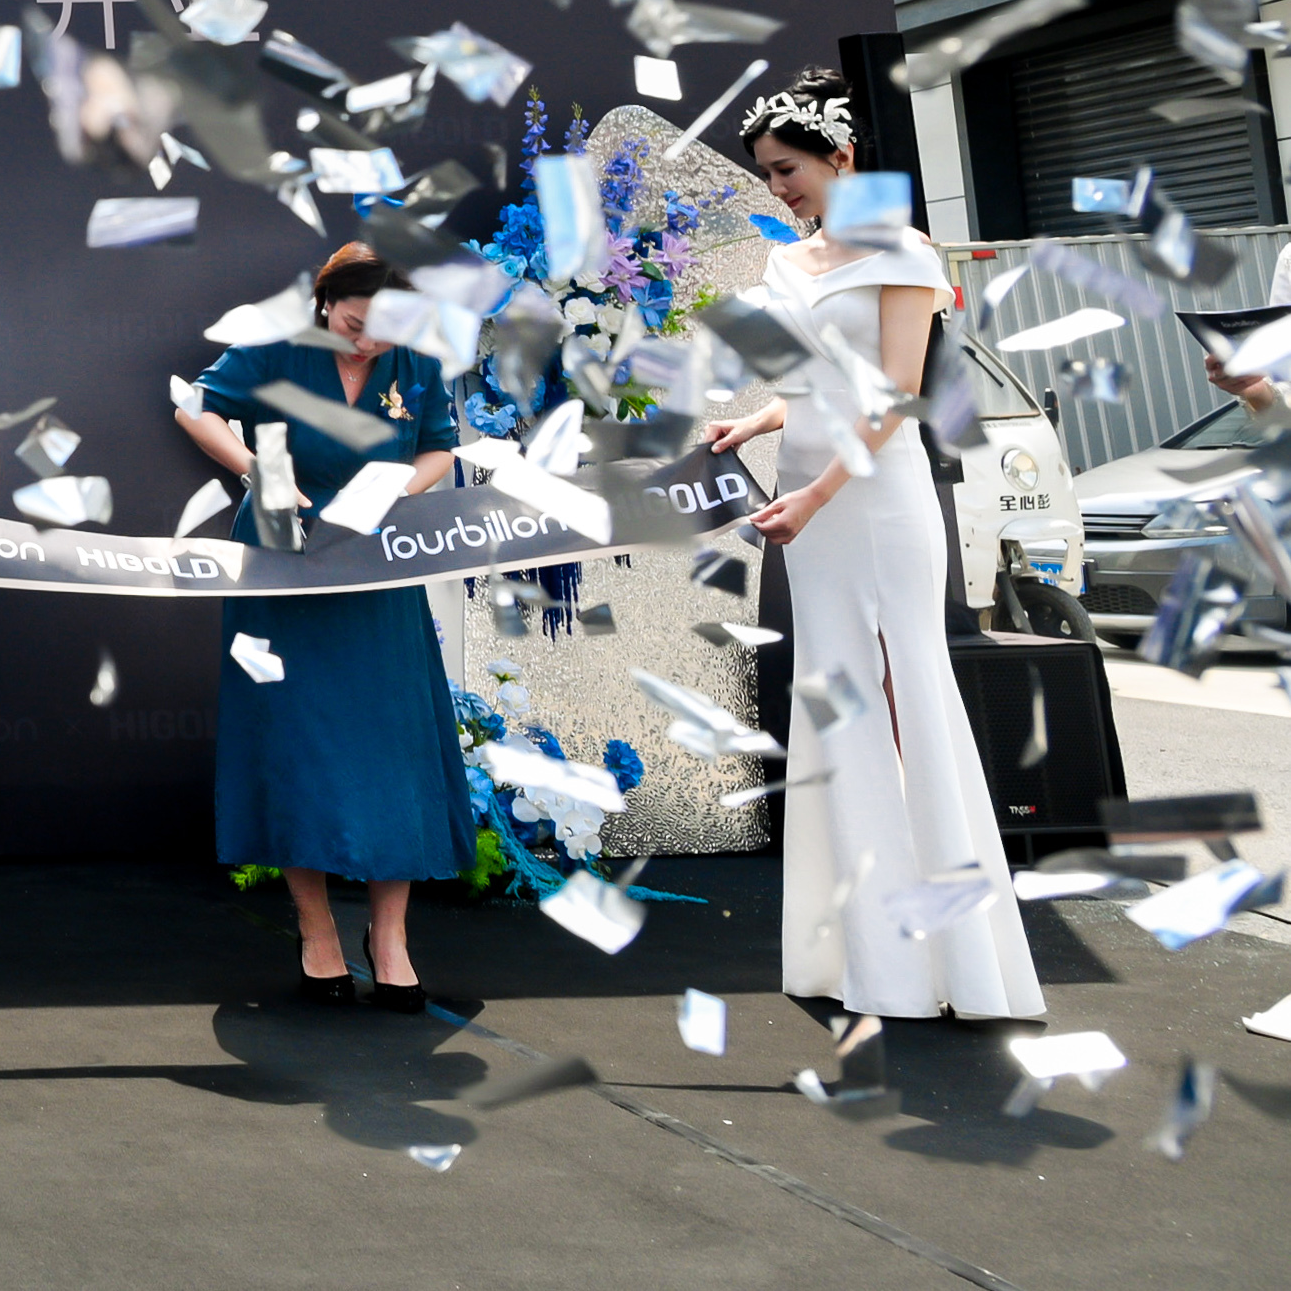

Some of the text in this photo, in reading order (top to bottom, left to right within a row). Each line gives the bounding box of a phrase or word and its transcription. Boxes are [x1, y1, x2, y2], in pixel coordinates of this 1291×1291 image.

[74, 546, 221, 580] HIGOLD
[372, 509, 568, 562] Tourbillon
[642, 472, 749, 515] OLD
